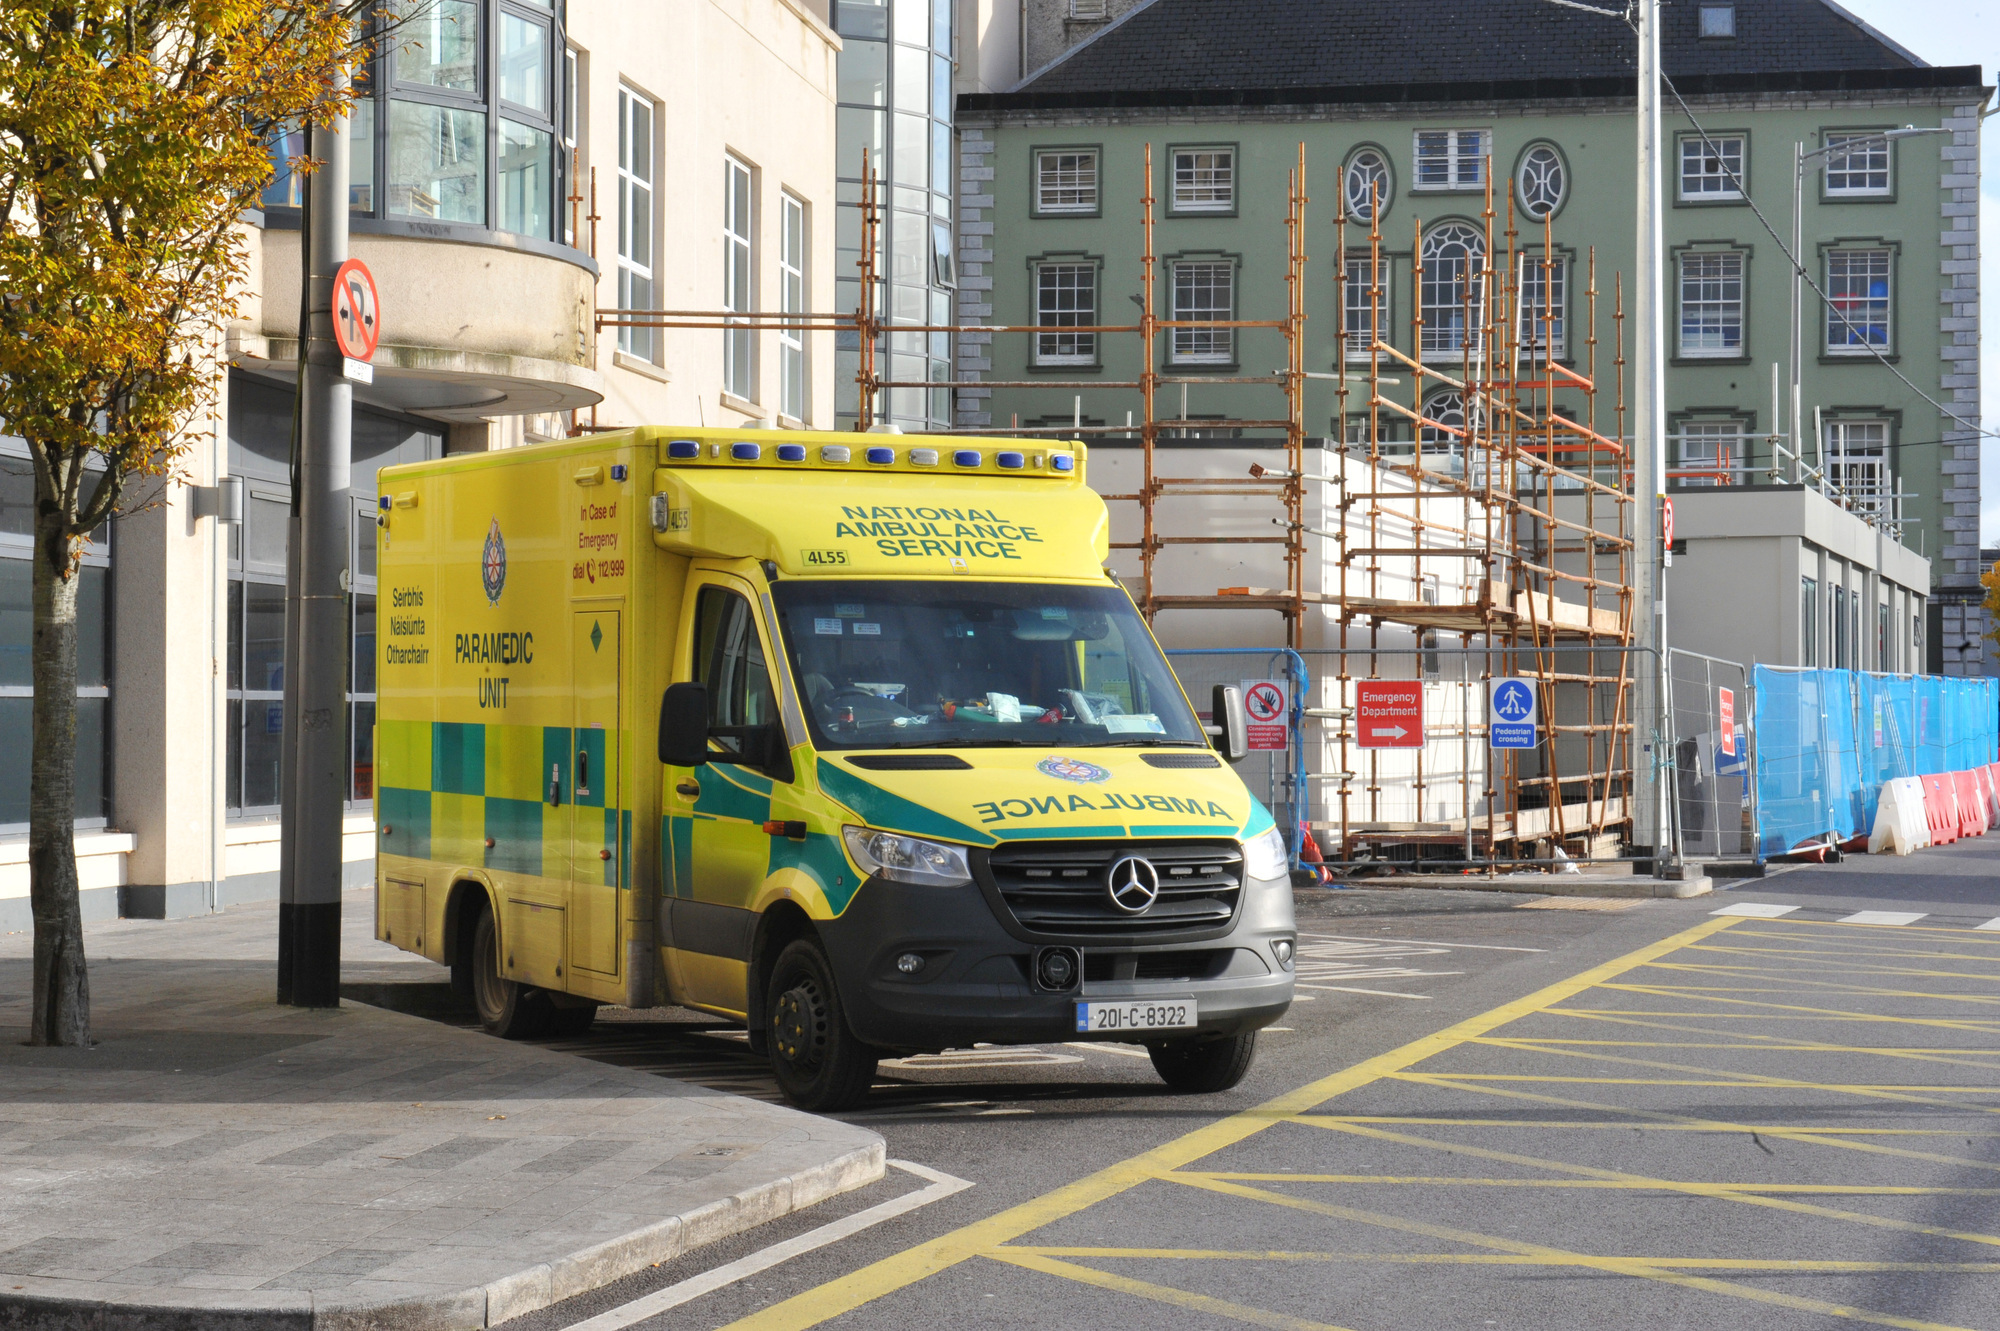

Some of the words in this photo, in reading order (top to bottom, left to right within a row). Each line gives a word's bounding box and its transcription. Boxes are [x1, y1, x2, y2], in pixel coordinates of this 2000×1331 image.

[580, 505, 587, 521] In
[589, 503, 607, 520] Case
[609, 501, 617, 518] of
[671, 511, 688, 529] 4L55
[840, 506, 1011, 524] NATIONAL
[579, 532, 618, 552] Emergency
[836, 522, 1044, 543] AMBULANCE
[808, 550, 846, 565] 4L55
[876, 539, 1022, 560] SERVICE
[572, 562, 585, 580] dial
[392, 585, 424, 608] Seirbhís
[390, 614, 425, 636] Náisiúnta
[386, 643, 429, 665] Otharchairr
[455, 631, 533, 664] PARAMEDIC
[478, 677, 509, 708] UNIT
[1362, 691, 1416, 705] Emergency
[1361, 706, 1418, 718] Department
[1495, 727, 1532, 735] Pedestrian
[1498, 735, 1528, 744] crossing
[1098, 1006, 1186, 1028] 201-C-8322
